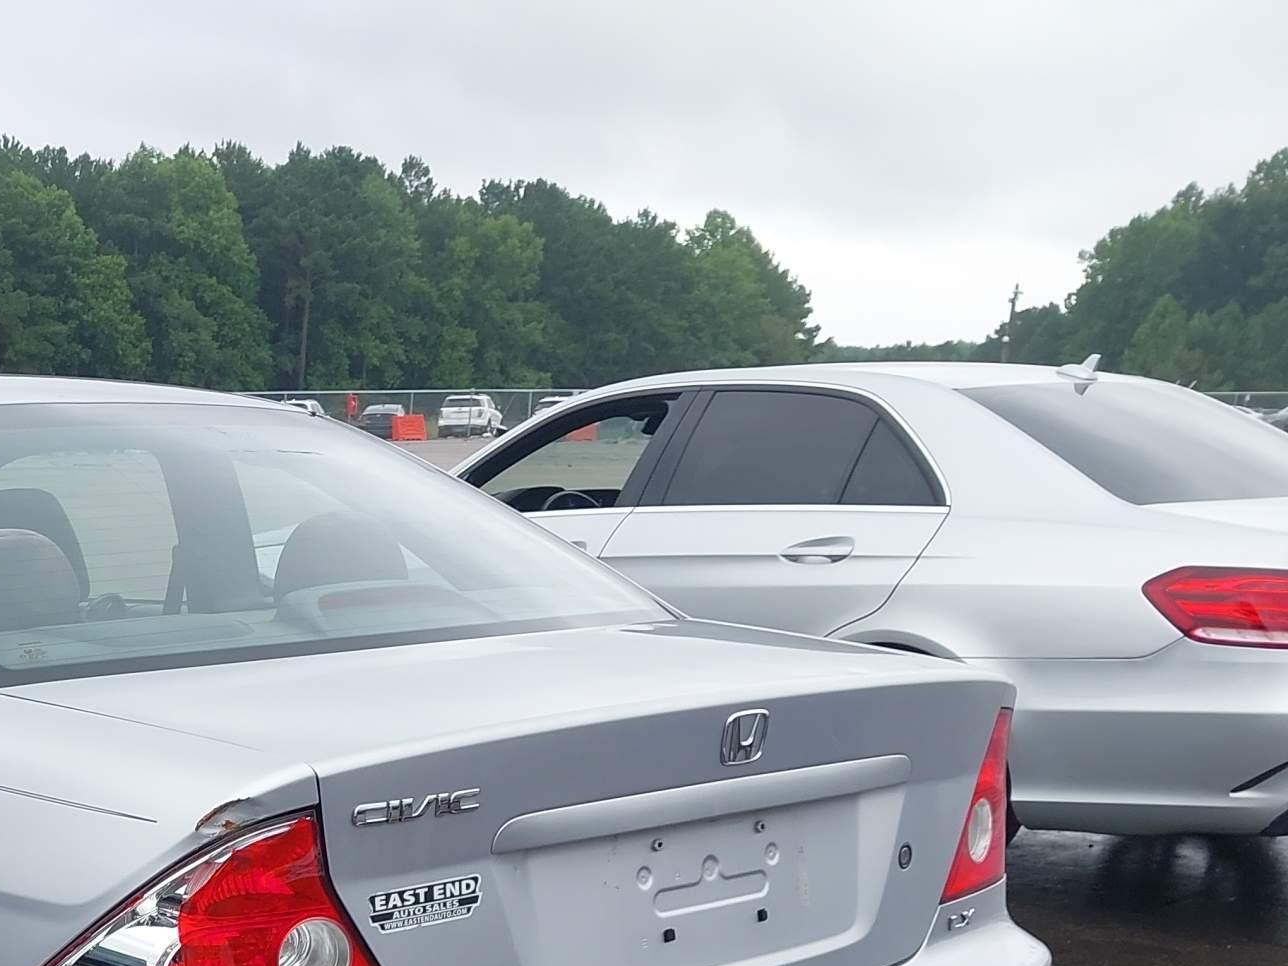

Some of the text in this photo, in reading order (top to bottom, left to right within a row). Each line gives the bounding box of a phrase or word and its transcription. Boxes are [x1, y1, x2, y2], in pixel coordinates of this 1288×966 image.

[352, 787, 480, 827] CIVIC
[374, 879, 476, 911] EAST END
[384, 907, 468, 930] WWW.EASTENDAUTO.COM
[392, 899, 460, 920] AUTO SALES
